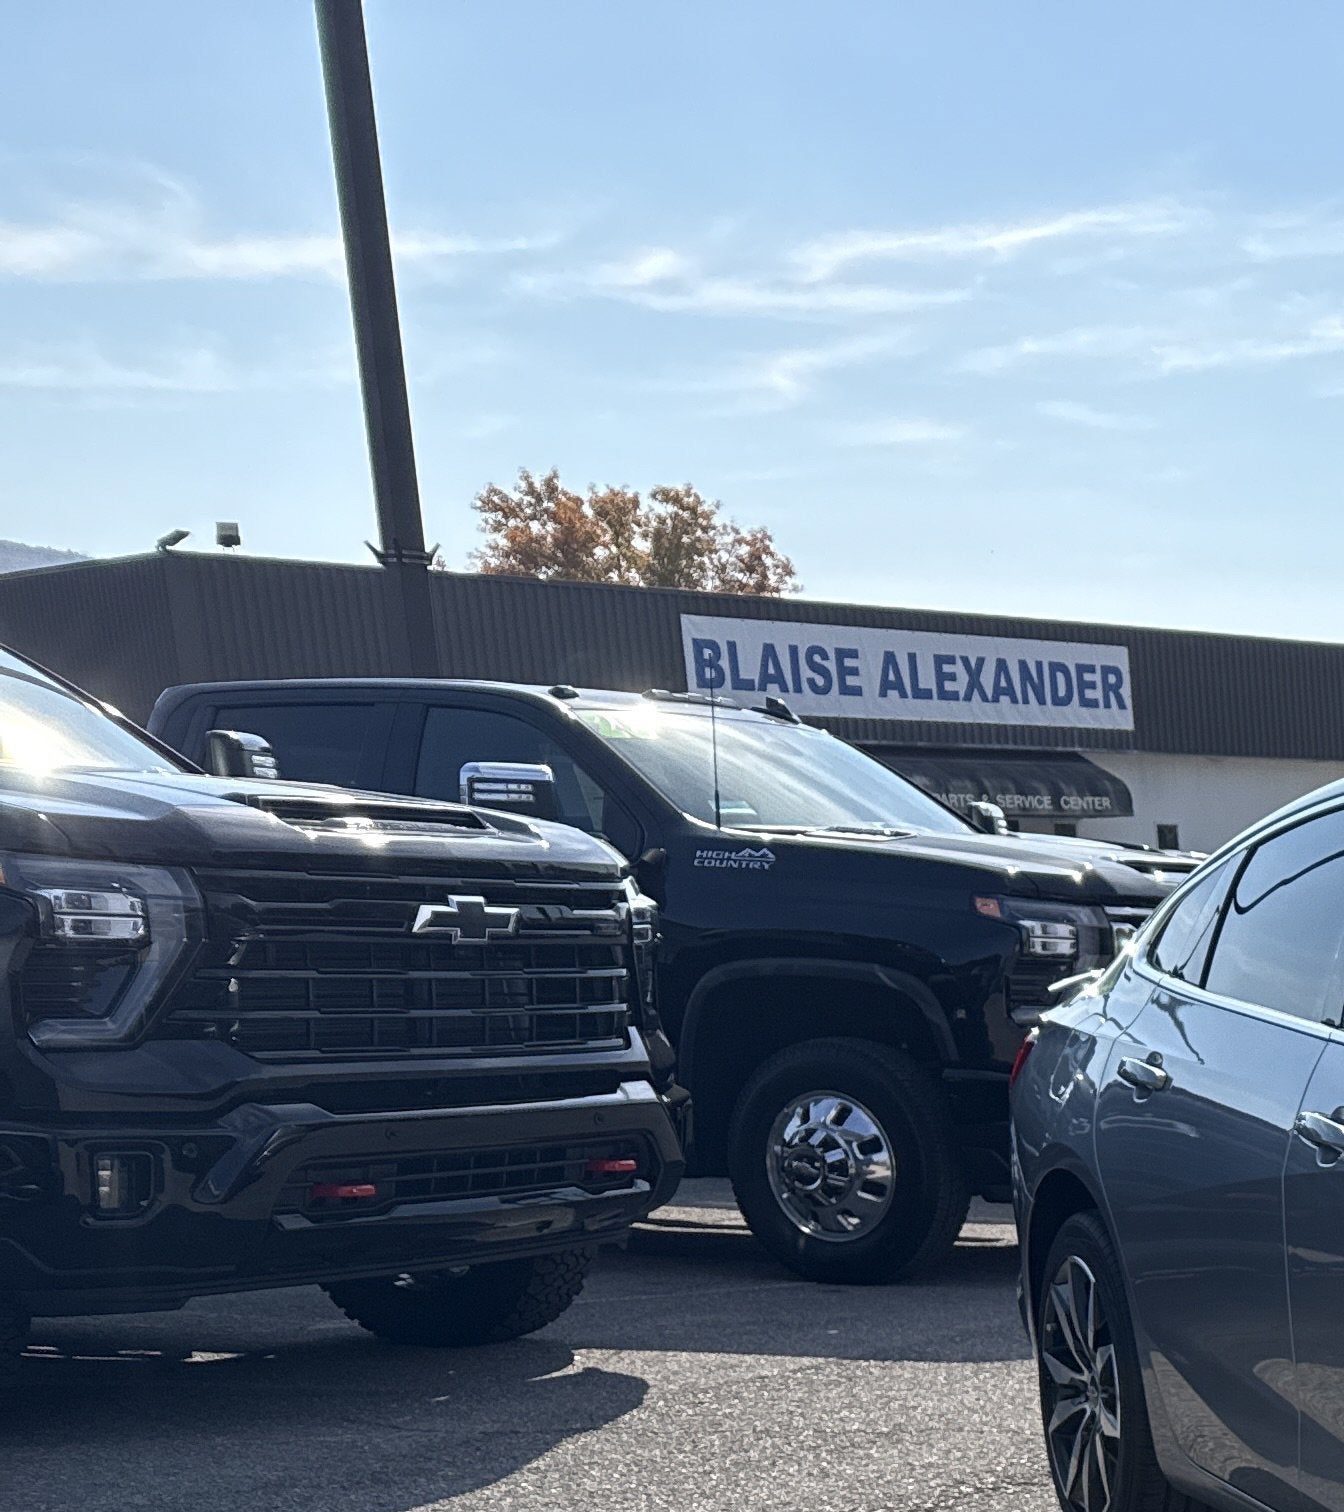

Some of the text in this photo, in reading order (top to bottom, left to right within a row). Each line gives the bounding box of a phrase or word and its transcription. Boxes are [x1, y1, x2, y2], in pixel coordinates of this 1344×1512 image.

[691, 637, 1128, 711] BLAISE ALEXANDER
[996, 794, 1053, 810] SERVICE
[1060, 796, 1112, 811] CENTER
[695, 849, 739, 860] HIGH
[693, 858, 775, 871] COUNTRY
